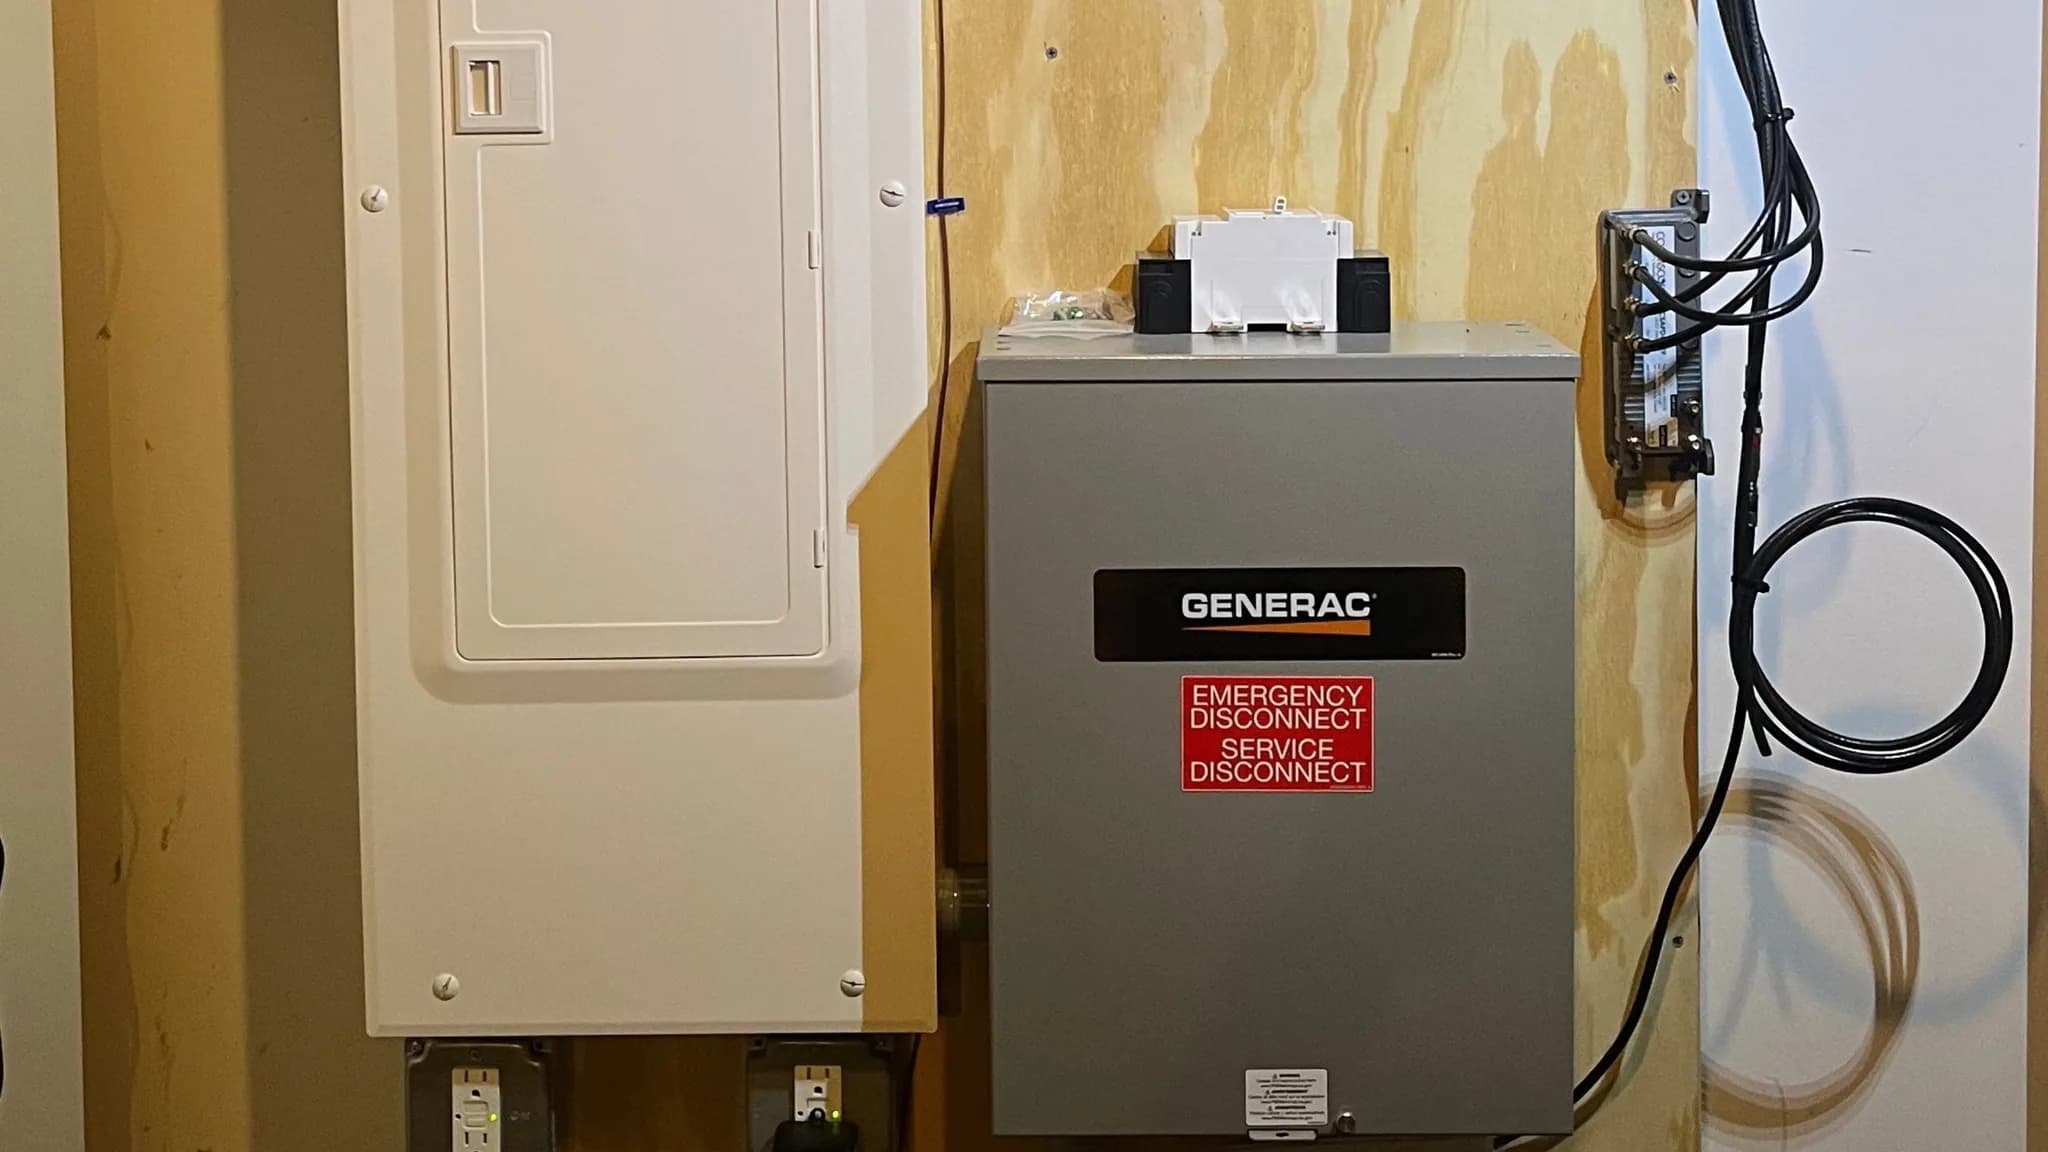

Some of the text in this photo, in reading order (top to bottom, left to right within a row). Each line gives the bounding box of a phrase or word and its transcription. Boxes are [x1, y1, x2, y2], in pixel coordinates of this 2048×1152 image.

[1181, 592, 1371, 619] GENERAC
[1193, 684, 1364, 707] EMERGENCY
[1190, 707, 1367, 729] DISCONNECT
[1221, 738, 1334, 760] SERVICE
[1190, 761, 1367, 783] DISCONNECT
